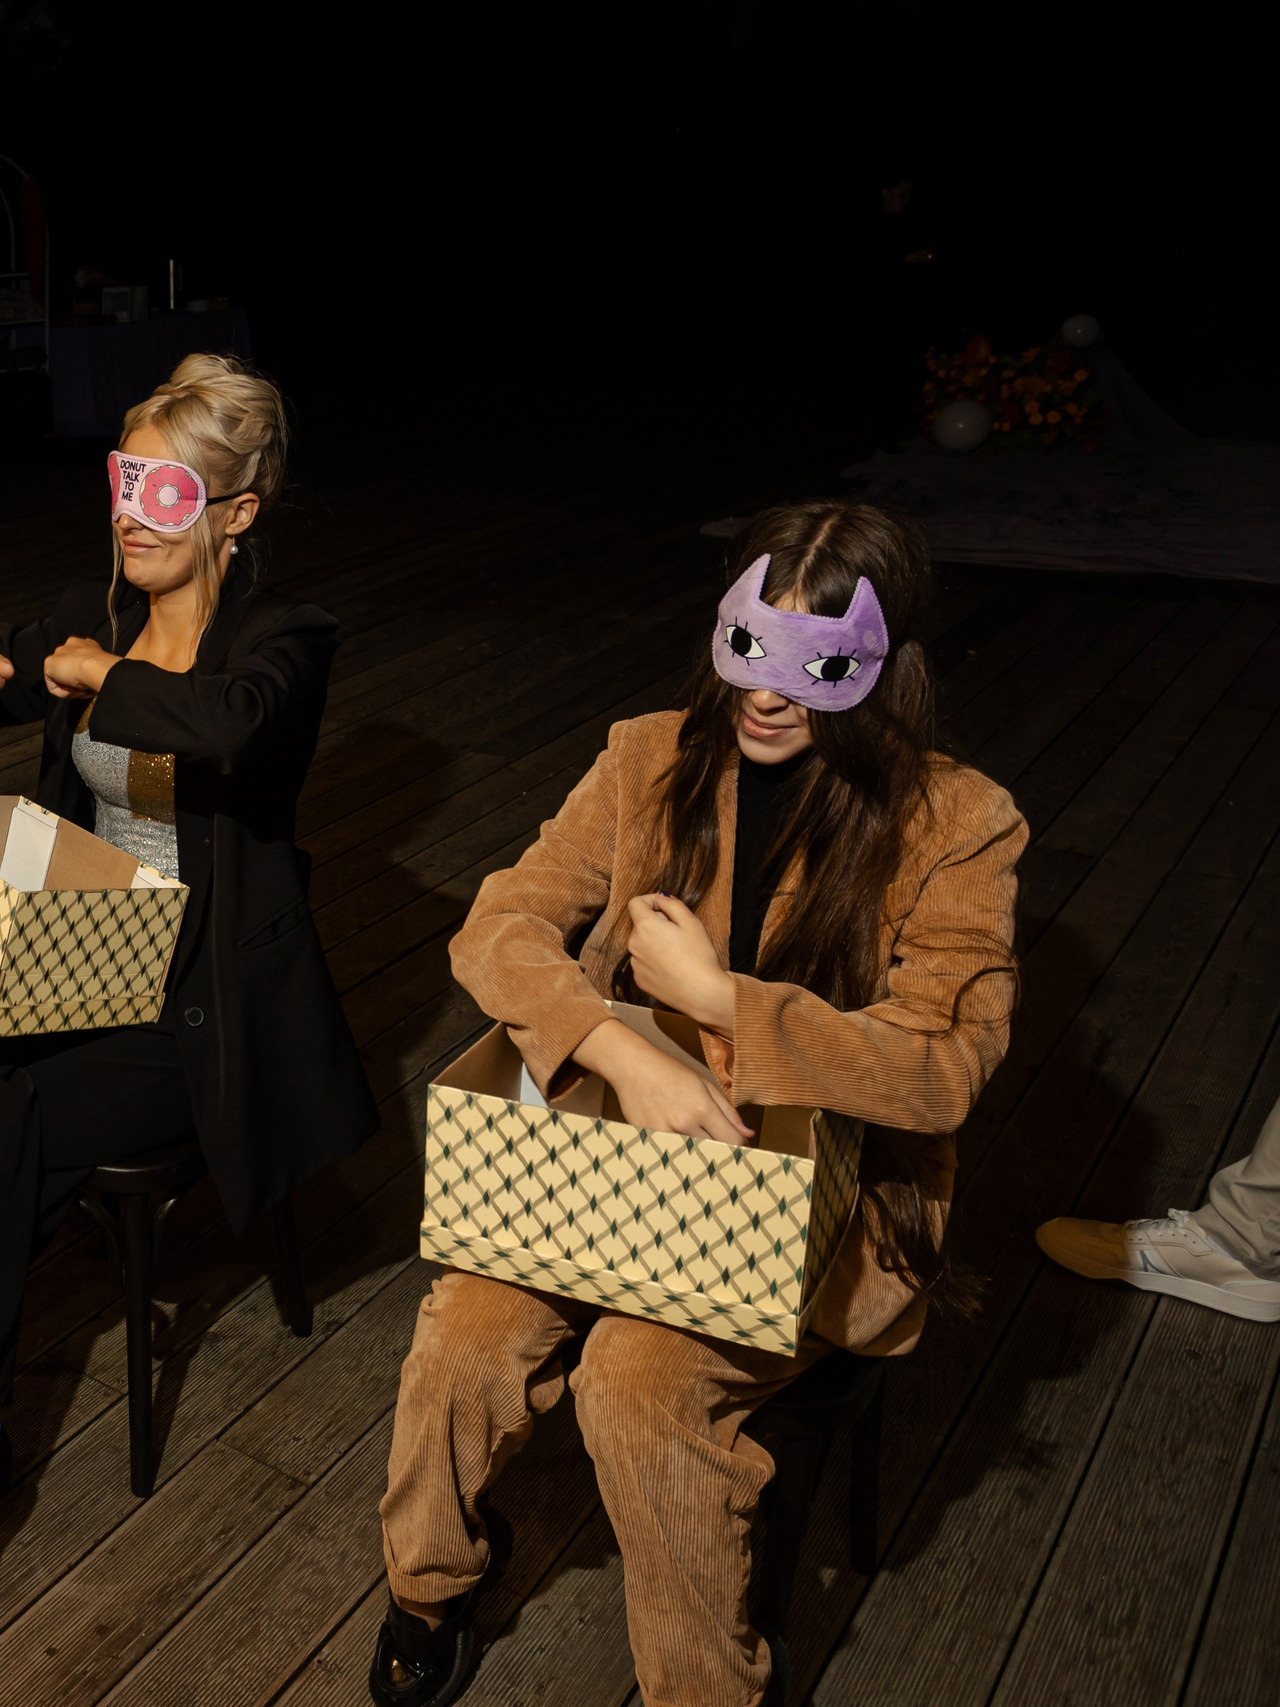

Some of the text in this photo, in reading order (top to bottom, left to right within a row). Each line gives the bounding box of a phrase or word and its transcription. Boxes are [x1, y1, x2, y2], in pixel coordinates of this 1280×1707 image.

[120, 459, 146, 473] DONUT
[123, 471, 140, 482] TALK
[125, 481, 134, 491] TO
[122, 491, 133, 501] ME
